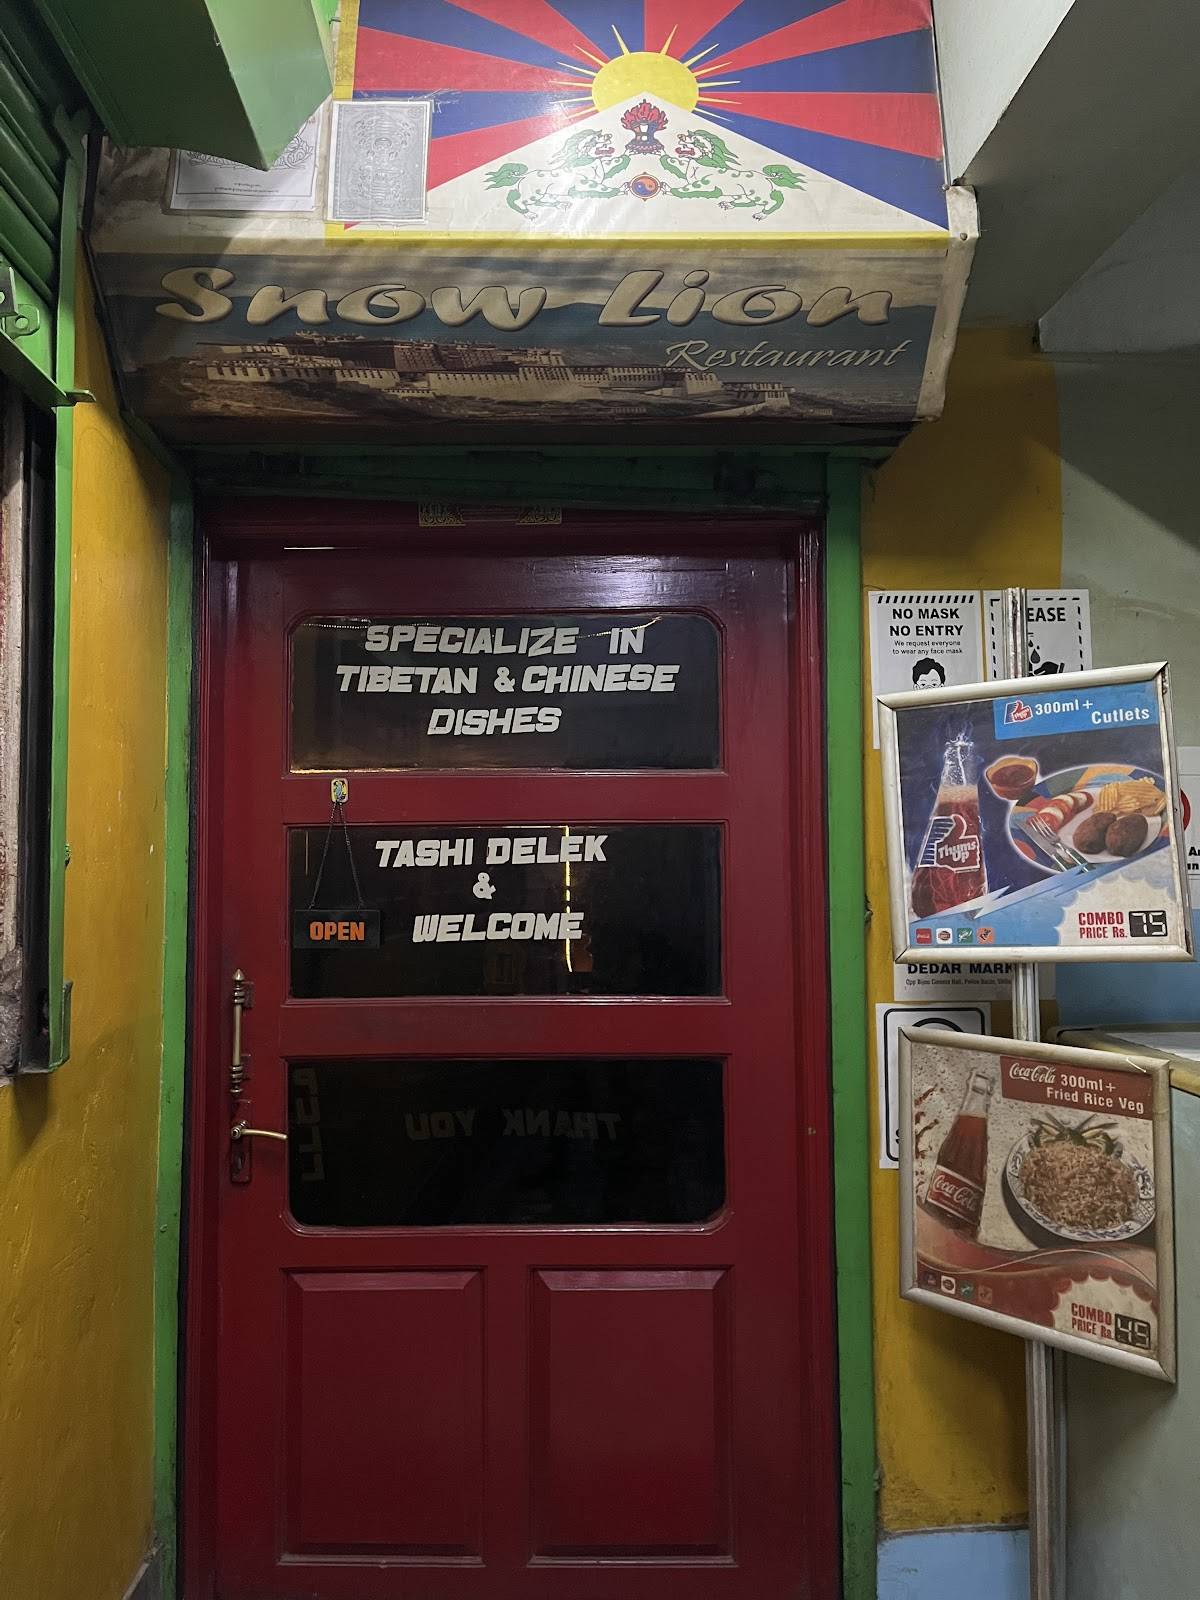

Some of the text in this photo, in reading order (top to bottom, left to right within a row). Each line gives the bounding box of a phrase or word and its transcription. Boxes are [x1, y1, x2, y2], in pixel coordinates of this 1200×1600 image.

[156, 266, 893, 332] Snow Lion
[664, 339, 912, 371] Restaurant
[892, 608, 960, 619] NO MASK
[1027, 607, 1066, 622] EASE
[365, 625, 646, 658] SPECIALIZE IN
[890, 625, 963, 636] NO ENTRY
[336, 664, 680, 694] TIBETAN & CHINESE
[427, 706, 562, 736] DISHES
[1091, 707, 1150, 725] Cutlets
[375, 835, 609, 868] TASHI DELEK
[938, 841, 976, 859] Thums
[472, 872, 496, 900] &
[412, 911, 585, 943] WELCOME
[1078, 911, 1124, 926] COMBO
[1131, 912, 1167, 936] 75
[309, 921, 365, 942] OPEN
[1079, 926, 1128, 939] PRICE Rs.
[907, 963, 961, 974] DEDAR
[1009, 1062, 1056, 1084] Coca-Cola
[1046, 1086, 1144, 1114] Fried Rice Veg
[1071, 1302, 1112, 1326] COMBO
[1071, 1317, 1096, 1335] PRICE
